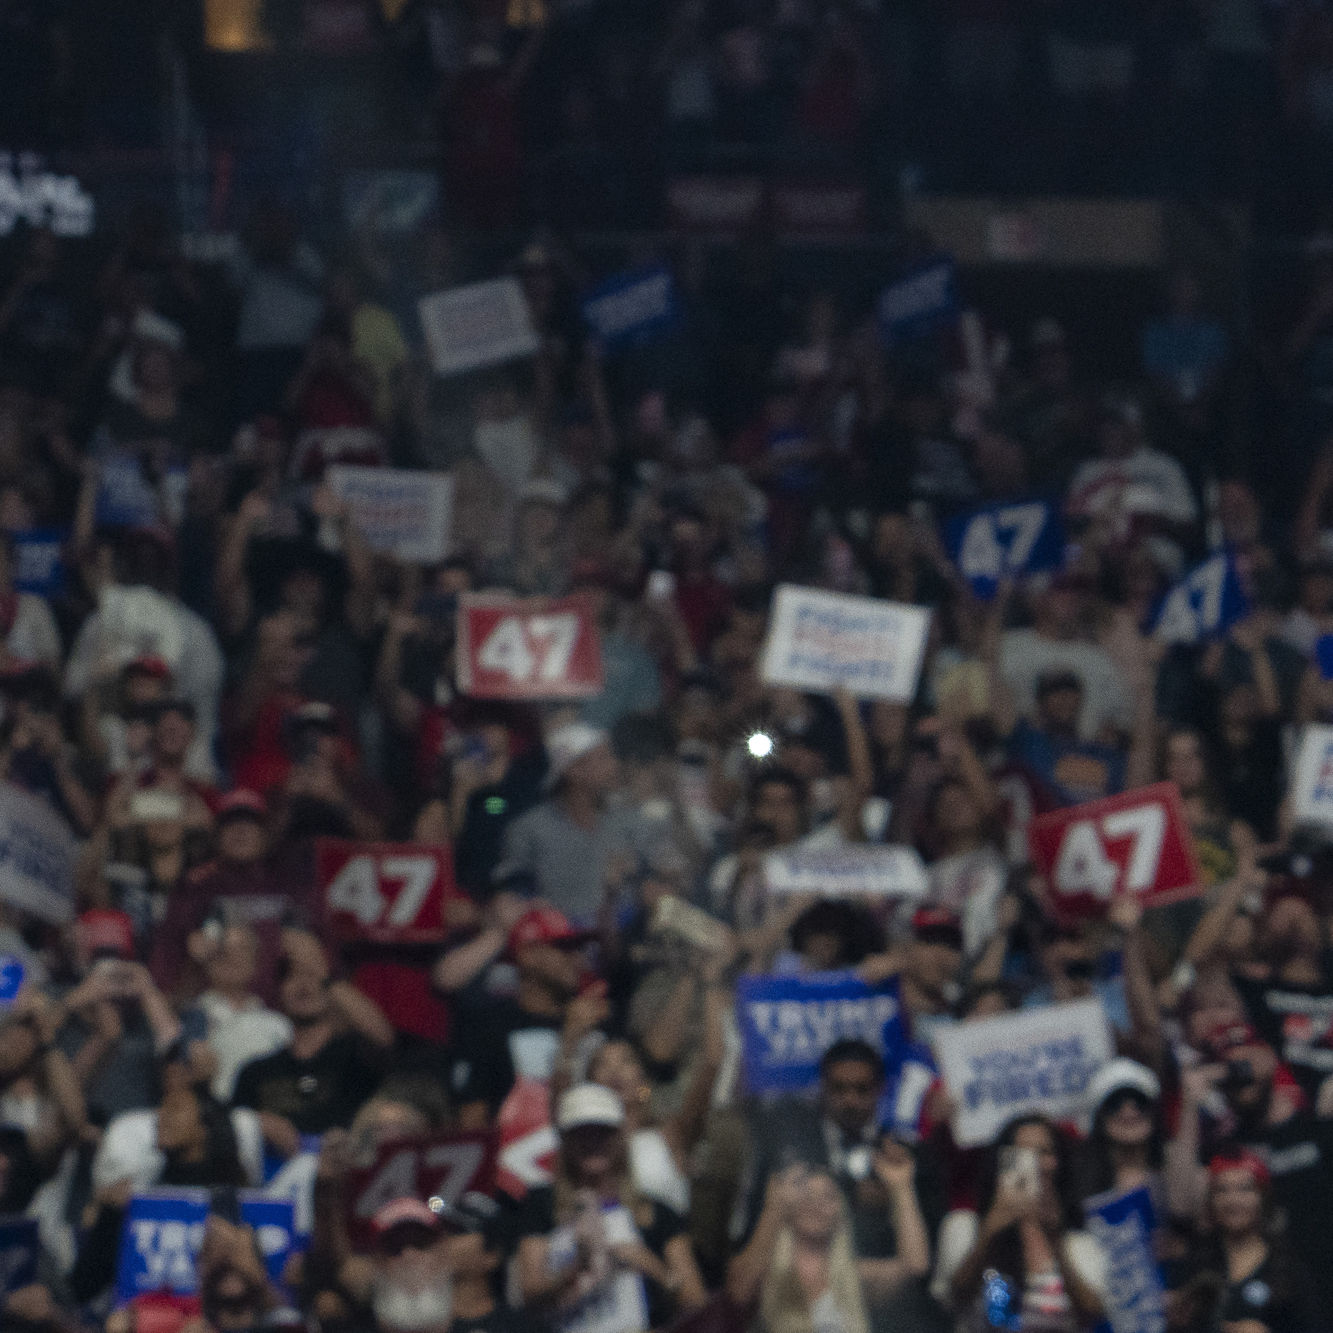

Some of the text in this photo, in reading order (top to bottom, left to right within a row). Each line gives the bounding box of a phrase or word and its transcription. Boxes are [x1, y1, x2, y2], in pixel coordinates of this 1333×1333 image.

[958, 504, 1048, 579] 47
[1155, 552, 1226, 644] 47
[478, 611, 580, 681] 47
[326, 853, 440, 926] 47
[1051, 803, 1167, 902] 47
